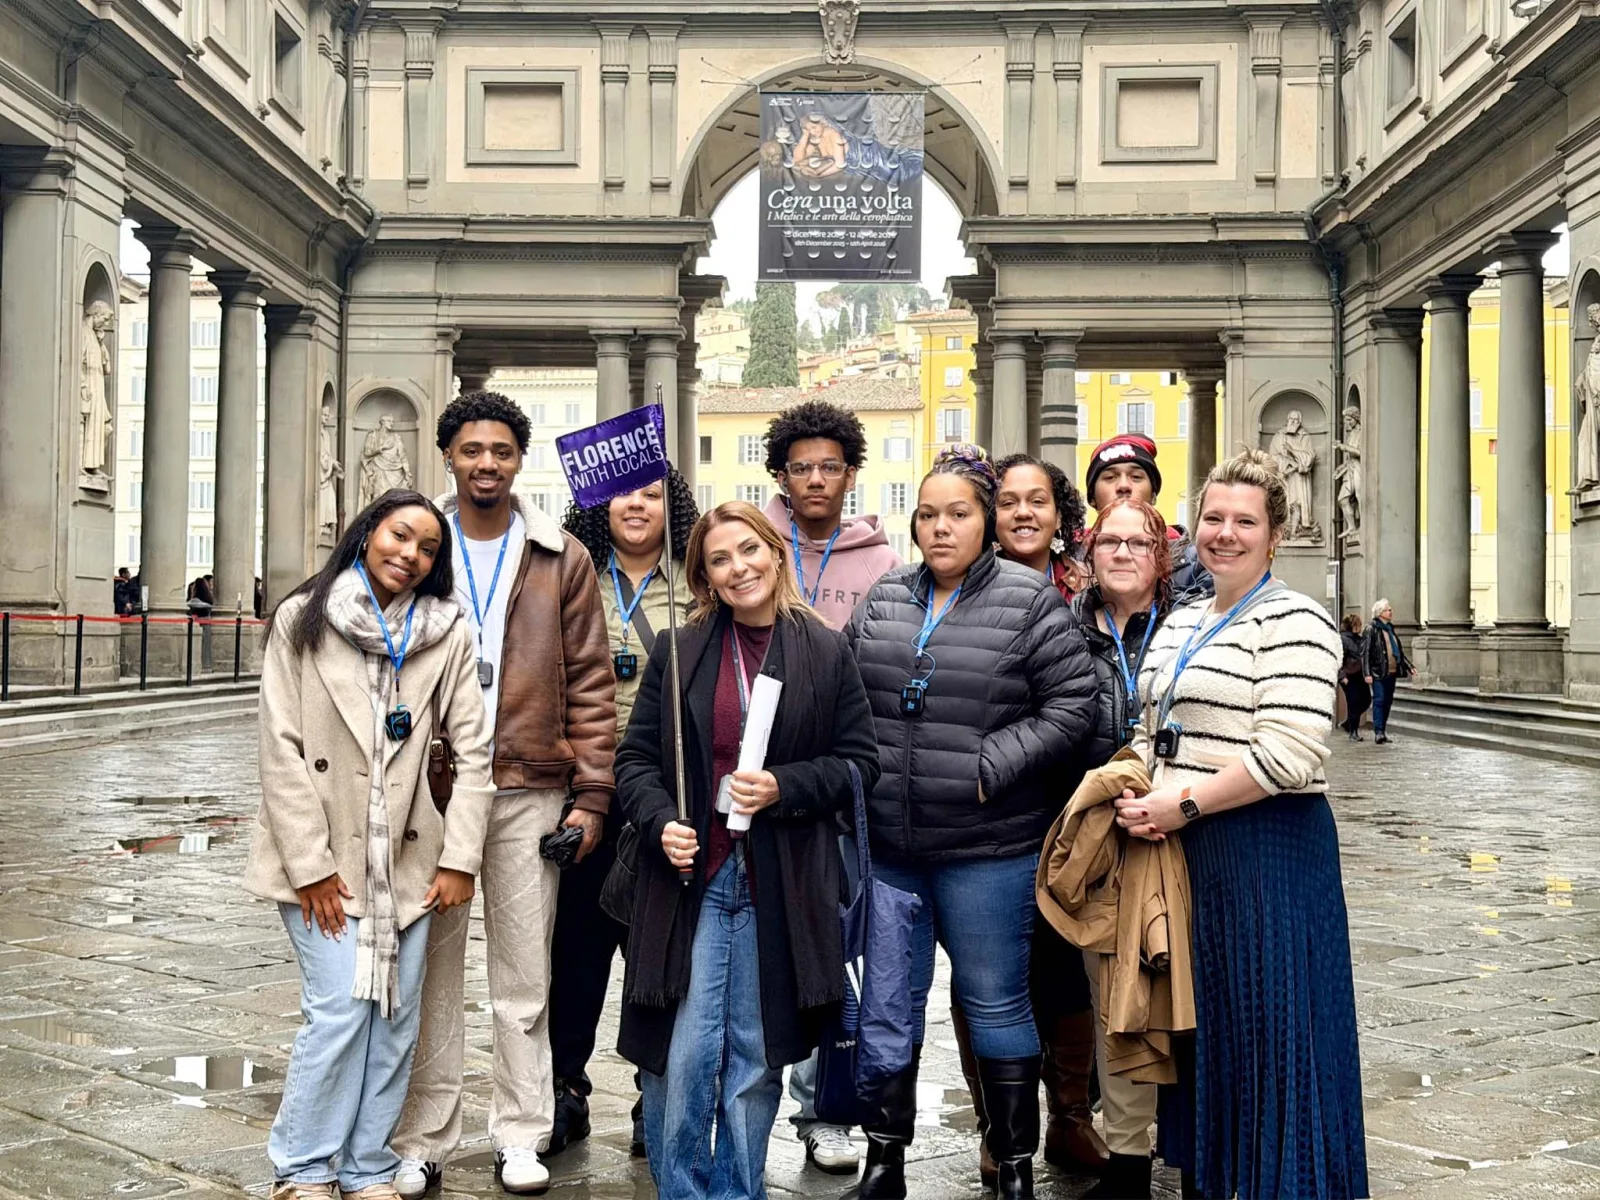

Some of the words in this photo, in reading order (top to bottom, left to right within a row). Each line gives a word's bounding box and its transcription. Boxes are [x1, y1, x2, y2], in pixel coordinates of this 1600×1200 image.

[767, 189, 813, 210] Cera
[818, 195, 857, 209] una
[861, 189, 913, 210] volta
[767, 211, 773, 221] I
[773, 211, 804, 221] Medici
[805, 213, 811, 221] e
[812, 212, 821, 221] le
[822, 212, 838, 221] arti
[839, 212, 861, 221] della
[862, 212, 913, 224] ceroplastica
[792, 230, 826, 238] dicere
[827, 231, 845, 239] 205
[857, 231, 878, 239] aple
[561, 422, 659, 476] FLORENCE
[569, 463, 610, 491] WITH
[611, 445, 664, 478] LOCALS
